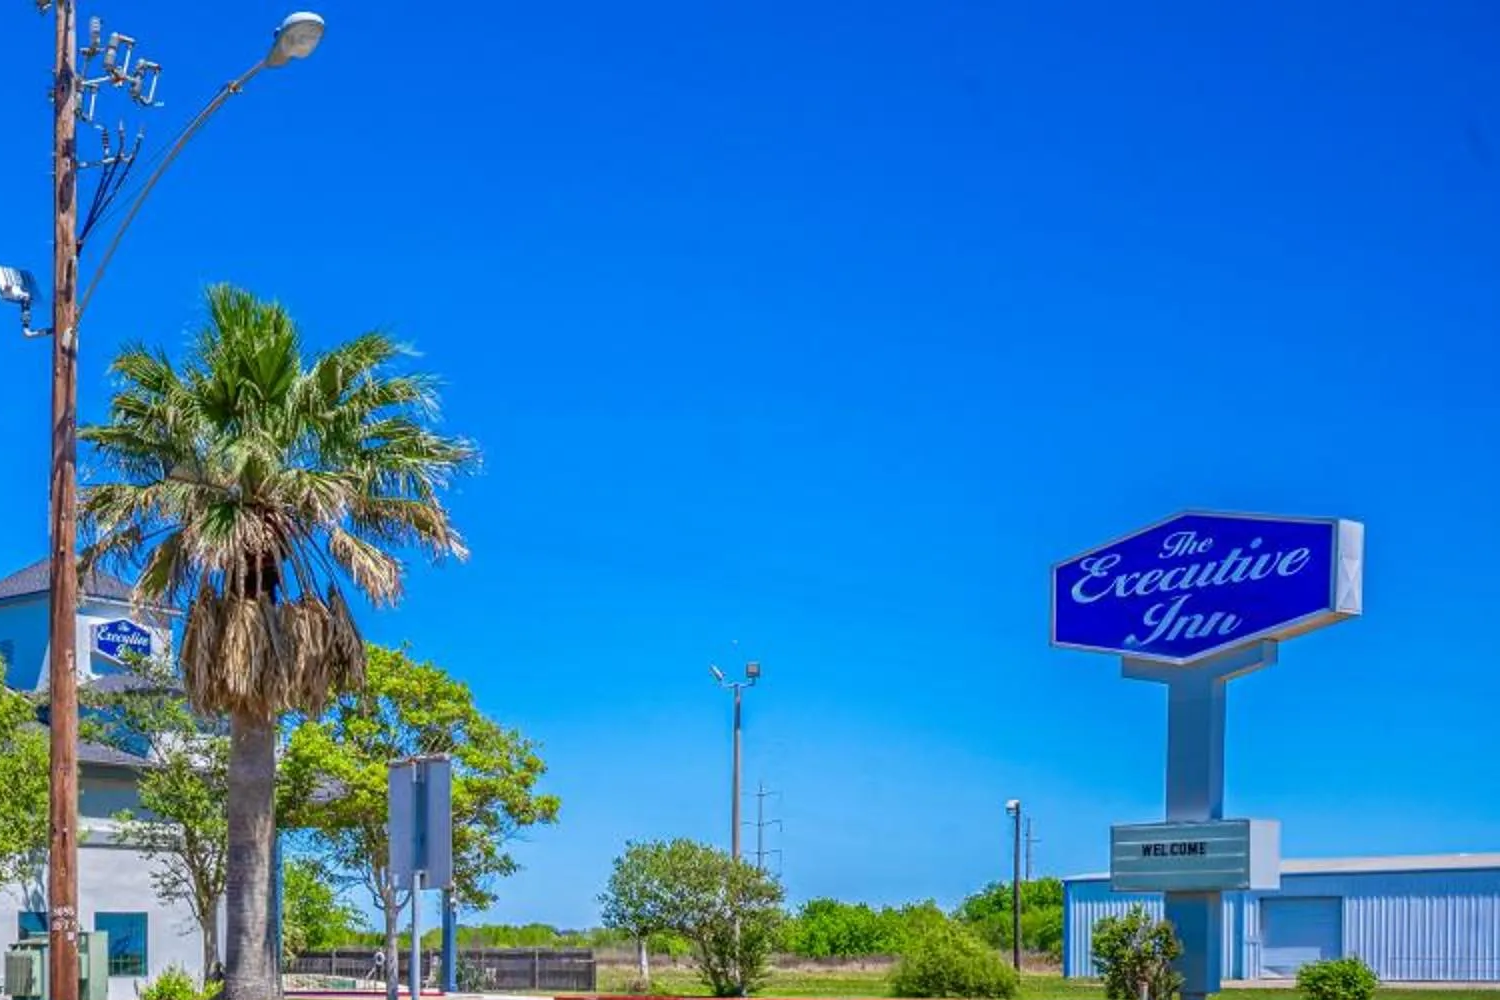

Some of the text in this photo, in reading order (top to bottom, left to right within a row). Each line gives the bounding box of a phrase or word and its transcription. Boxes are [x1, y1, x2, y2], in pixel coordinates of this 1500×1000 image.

[1159, 531, 1213, 559] The
[1071, 537, 1311, 603] Executive
[1124, 593, 1243, 649] Inn
[1142, 841, 1207, 857] WELCOME
